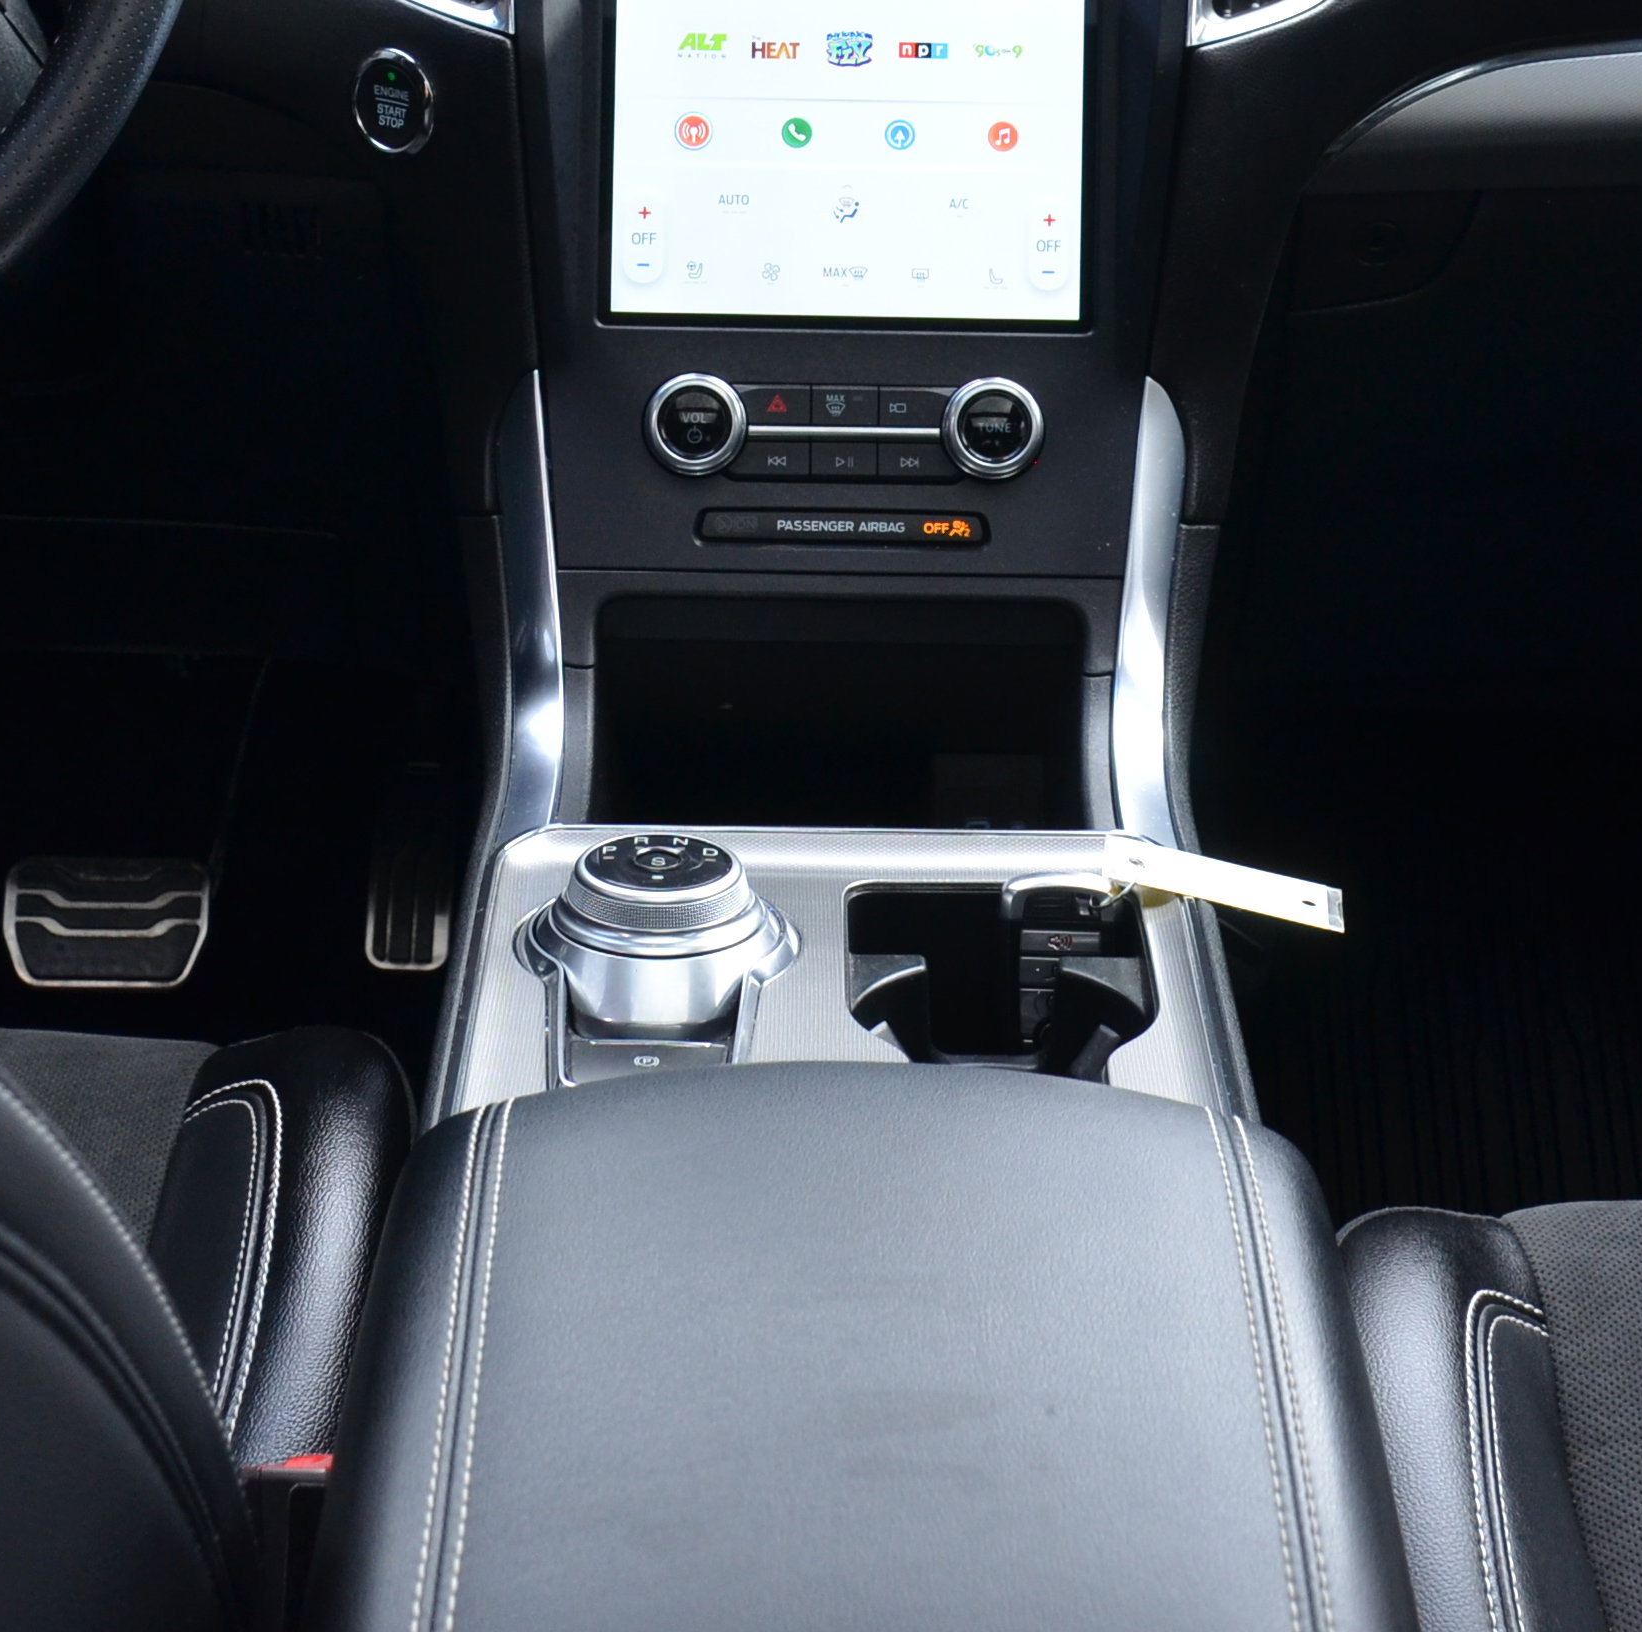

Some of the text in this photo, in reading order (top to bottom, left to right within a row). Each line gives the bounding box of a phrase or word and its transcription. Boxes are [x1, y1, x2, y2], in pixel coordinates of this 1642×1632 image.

[678, 33, 728, 51] ALT
[751, 42, 801, 59] HEAT
[900, 43, 946, 58] npr
[373, 84, 410, 102] ENGINE
[377, 103, 407, 119] START
[378, 115, 404, 129] STOP
[718, 193, 750, 206] AUTO
[949, 197, 970, 210] A/C
[631, 232, 657, 246] OFF
[1036, 239, 1062, 254] OFF
[823, 266, 848, 279] MAX
[825, 394, 845, 403] MAX
[682, 412, 707, 424] VOL
[978, 422, 1013, 433] TUNE
[777, 520, 949, 535] PASSENGER AIRBAG OFF
[634, 837, 649, 845] R
[673, 838, 689, 846] N
[602, 846, 617, 855] P
[702, 848, 719, 856] D
[651, 857, 667, 866] S
